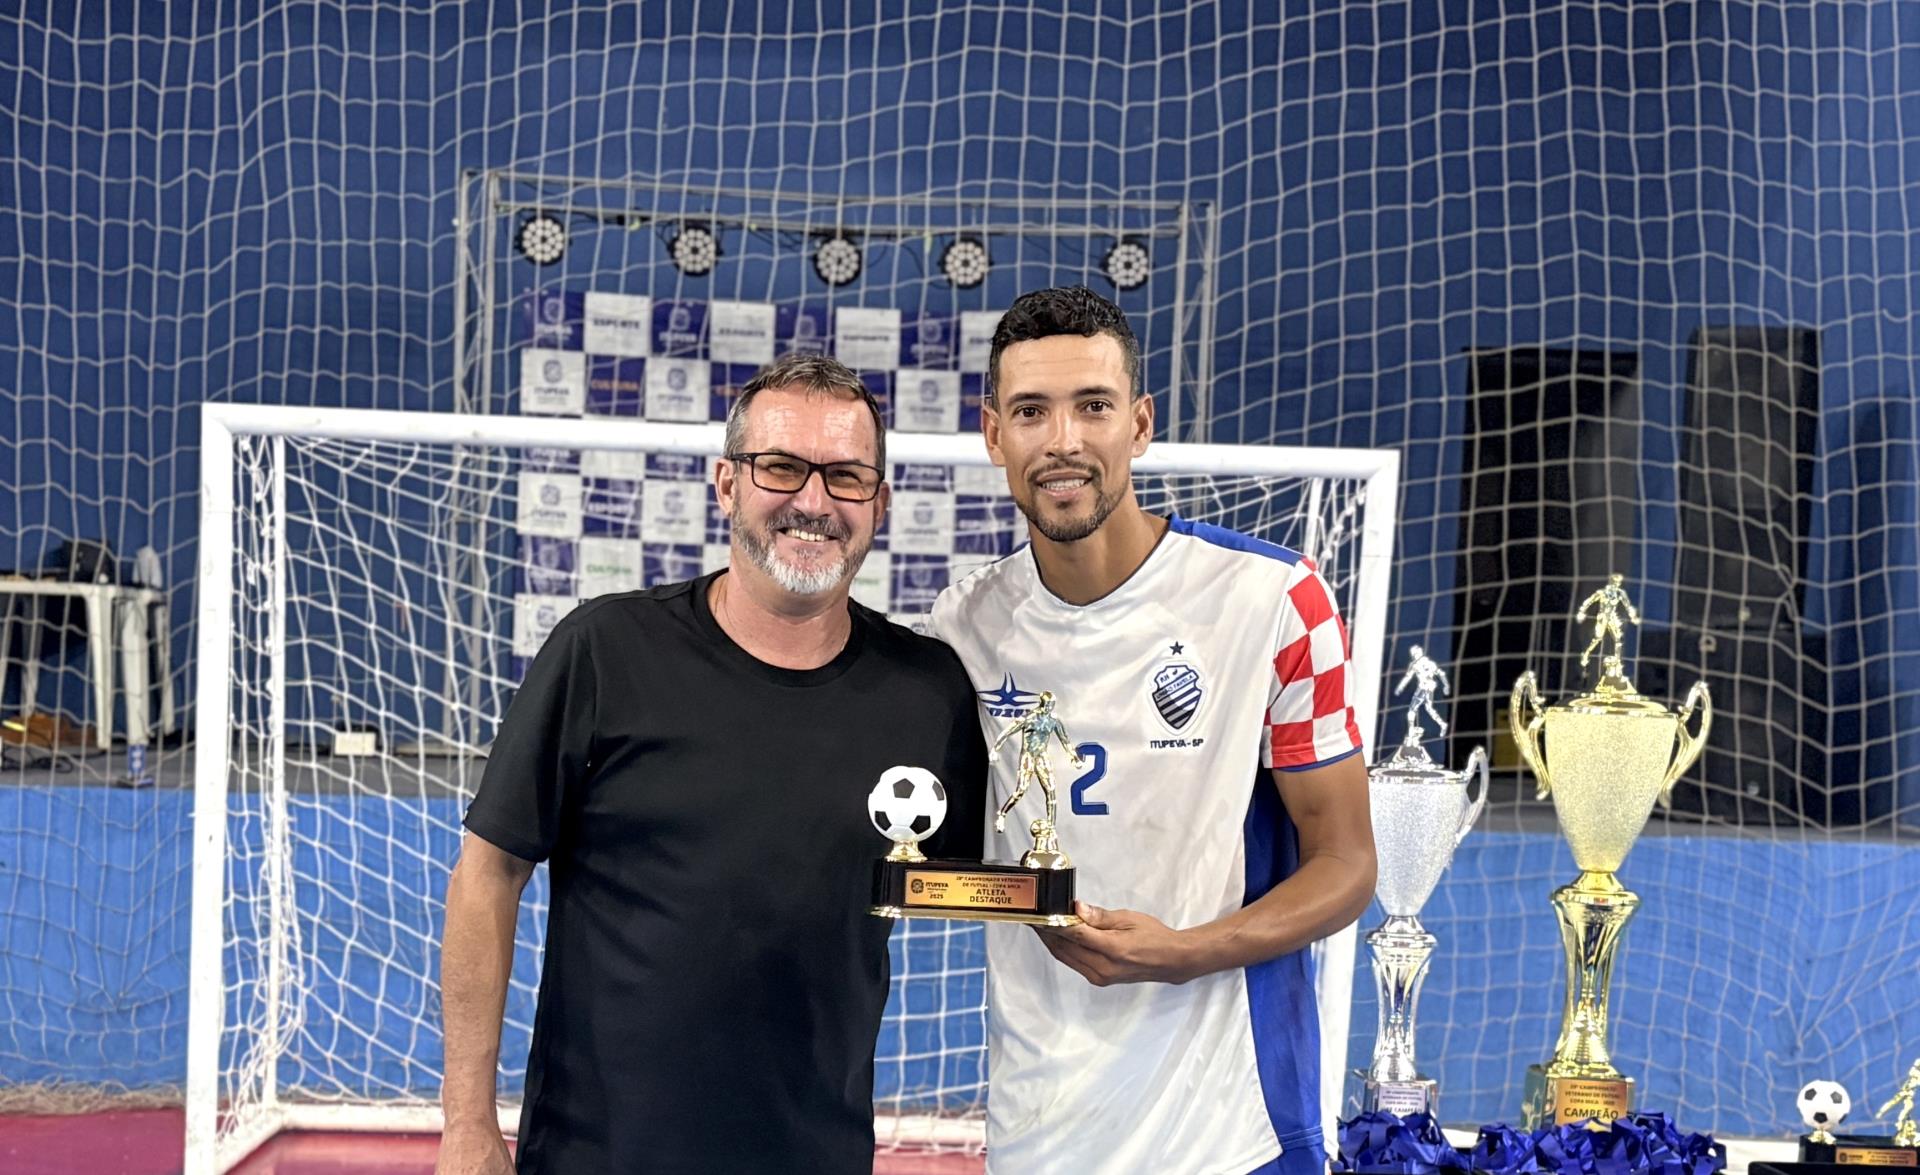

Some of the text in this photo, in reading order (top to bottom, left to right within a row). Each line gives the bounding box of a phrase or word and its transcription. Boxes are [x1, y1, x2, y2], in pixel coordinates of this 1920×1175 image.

[1150, 739, 1187, 749] ITUPEVA
[1192, 738, 1204, 748] SP
[1071, 742, 1109, 815] 2
[976, 888, 1006, 896] ATLETA
[969, 895, 1013, 904] DESTAQUE
[1564, 1107, 1619, 1120] CAMPEÃO
